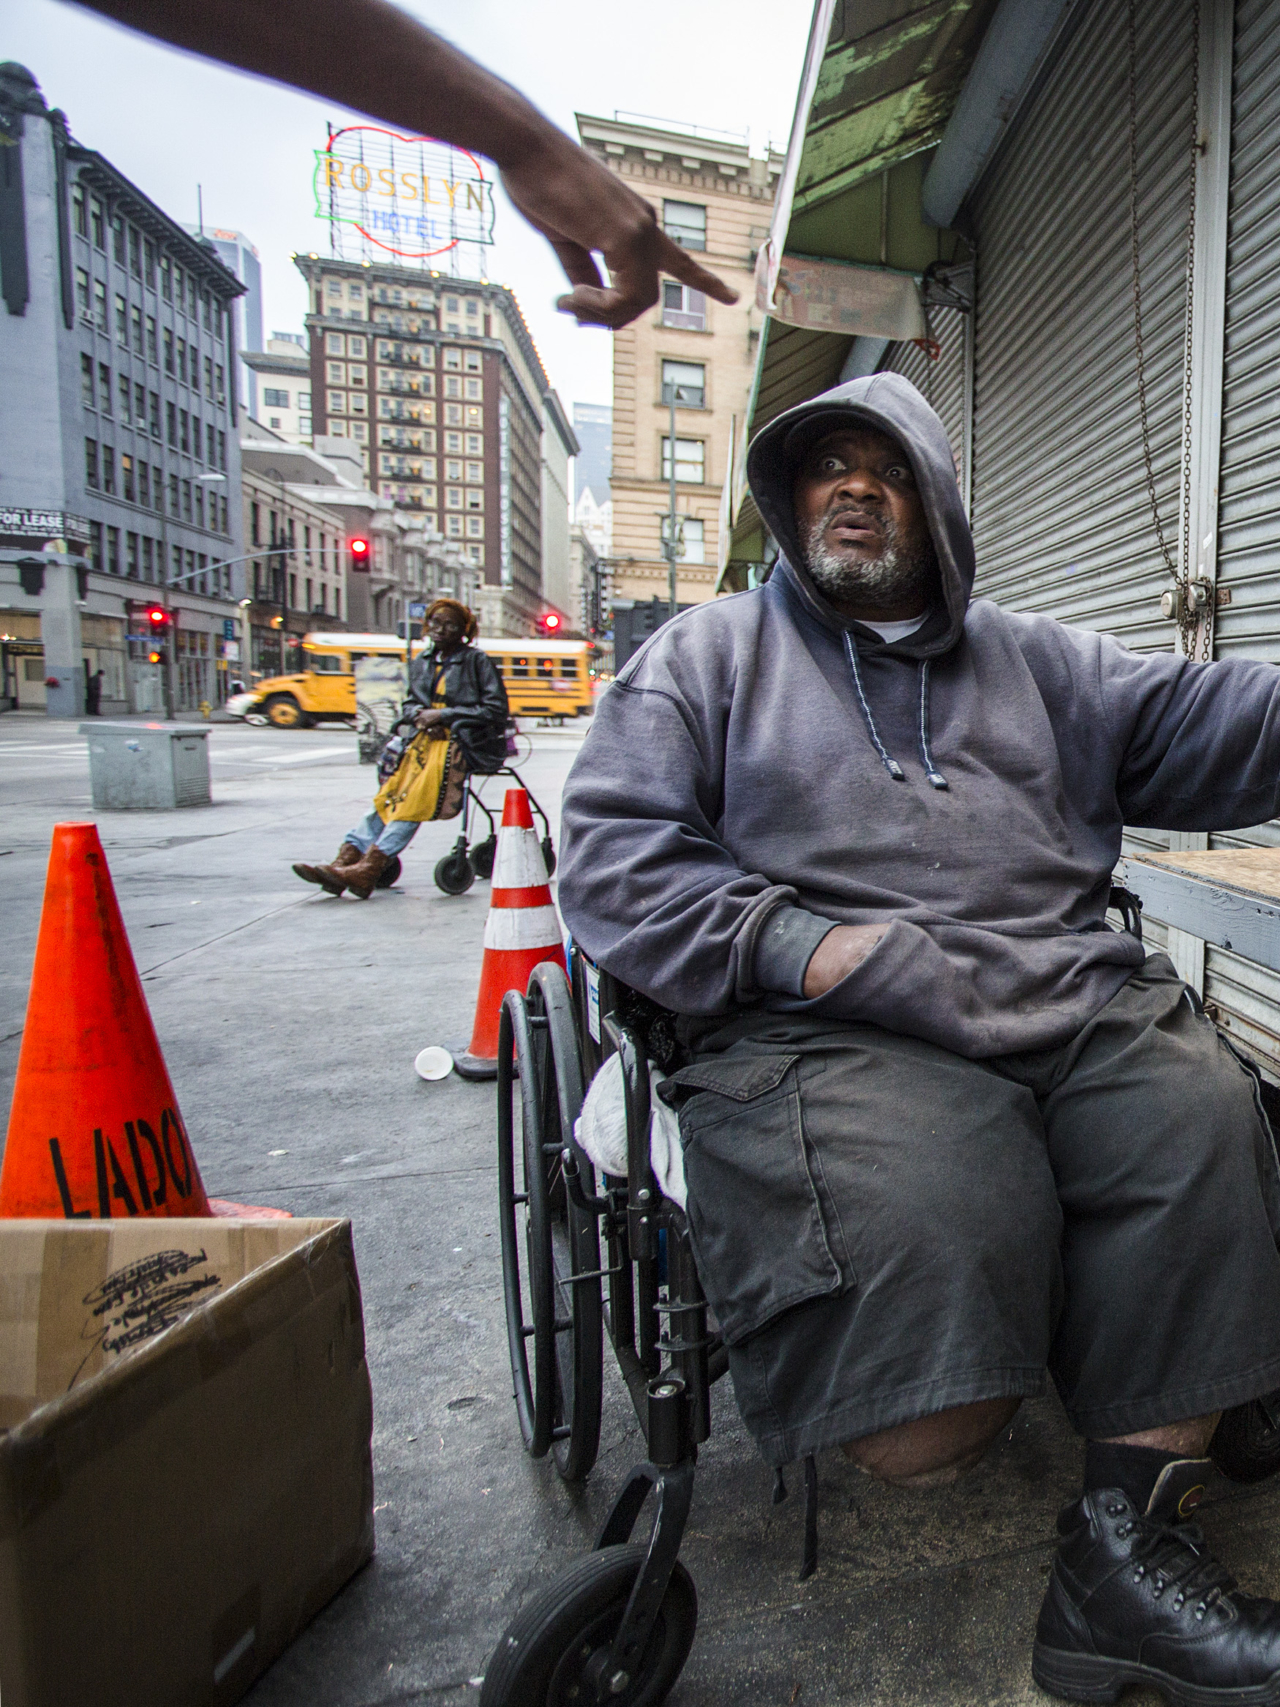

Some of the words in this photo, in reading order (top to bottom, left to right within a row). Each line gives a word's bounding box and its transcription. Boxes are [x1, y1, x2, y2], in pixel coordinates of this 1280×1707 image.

[324, 157, 483, 213] ROSSLYN
[372, 210, 443, 240] HOTEL
[22, 514, 64, 528] LEASE
